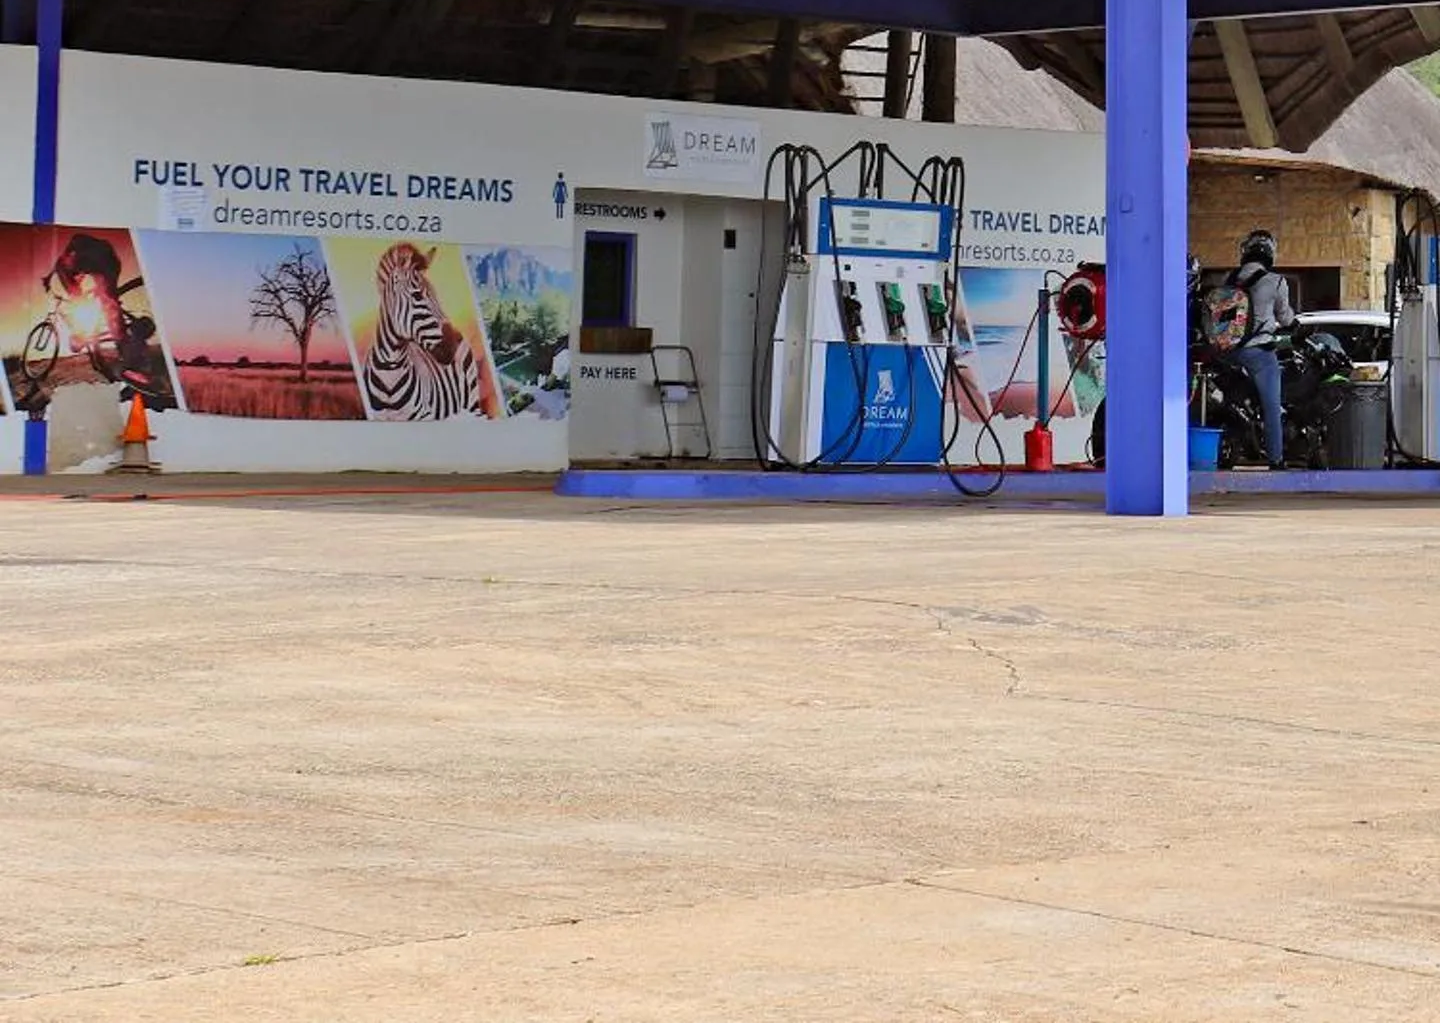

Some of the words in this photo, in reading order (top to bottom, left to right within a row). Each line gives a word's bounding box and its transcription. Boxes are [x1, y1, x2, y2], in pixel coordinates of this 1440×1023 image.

[683, 131, 756, 155] DREAM
[134, 160, 204, 186] FUEL
[213, 164, 291, 192] YOUR
[299, 169, 398, 197] TRAVEL
[407, 174, 513, 203] DREAMS
[213, 198, 442, 233] dreamresorts.co.za
[575, 202, 648, 219] RESTROOMS
[969, 210, 1043, 233] TRAVEL
[1050, 214, 1106, 236] DREA
[951, 244, 1075, 263] resorts.co.za
[580, 365, 601, 379] PAY
[605, 367, 637, 379] HERE
